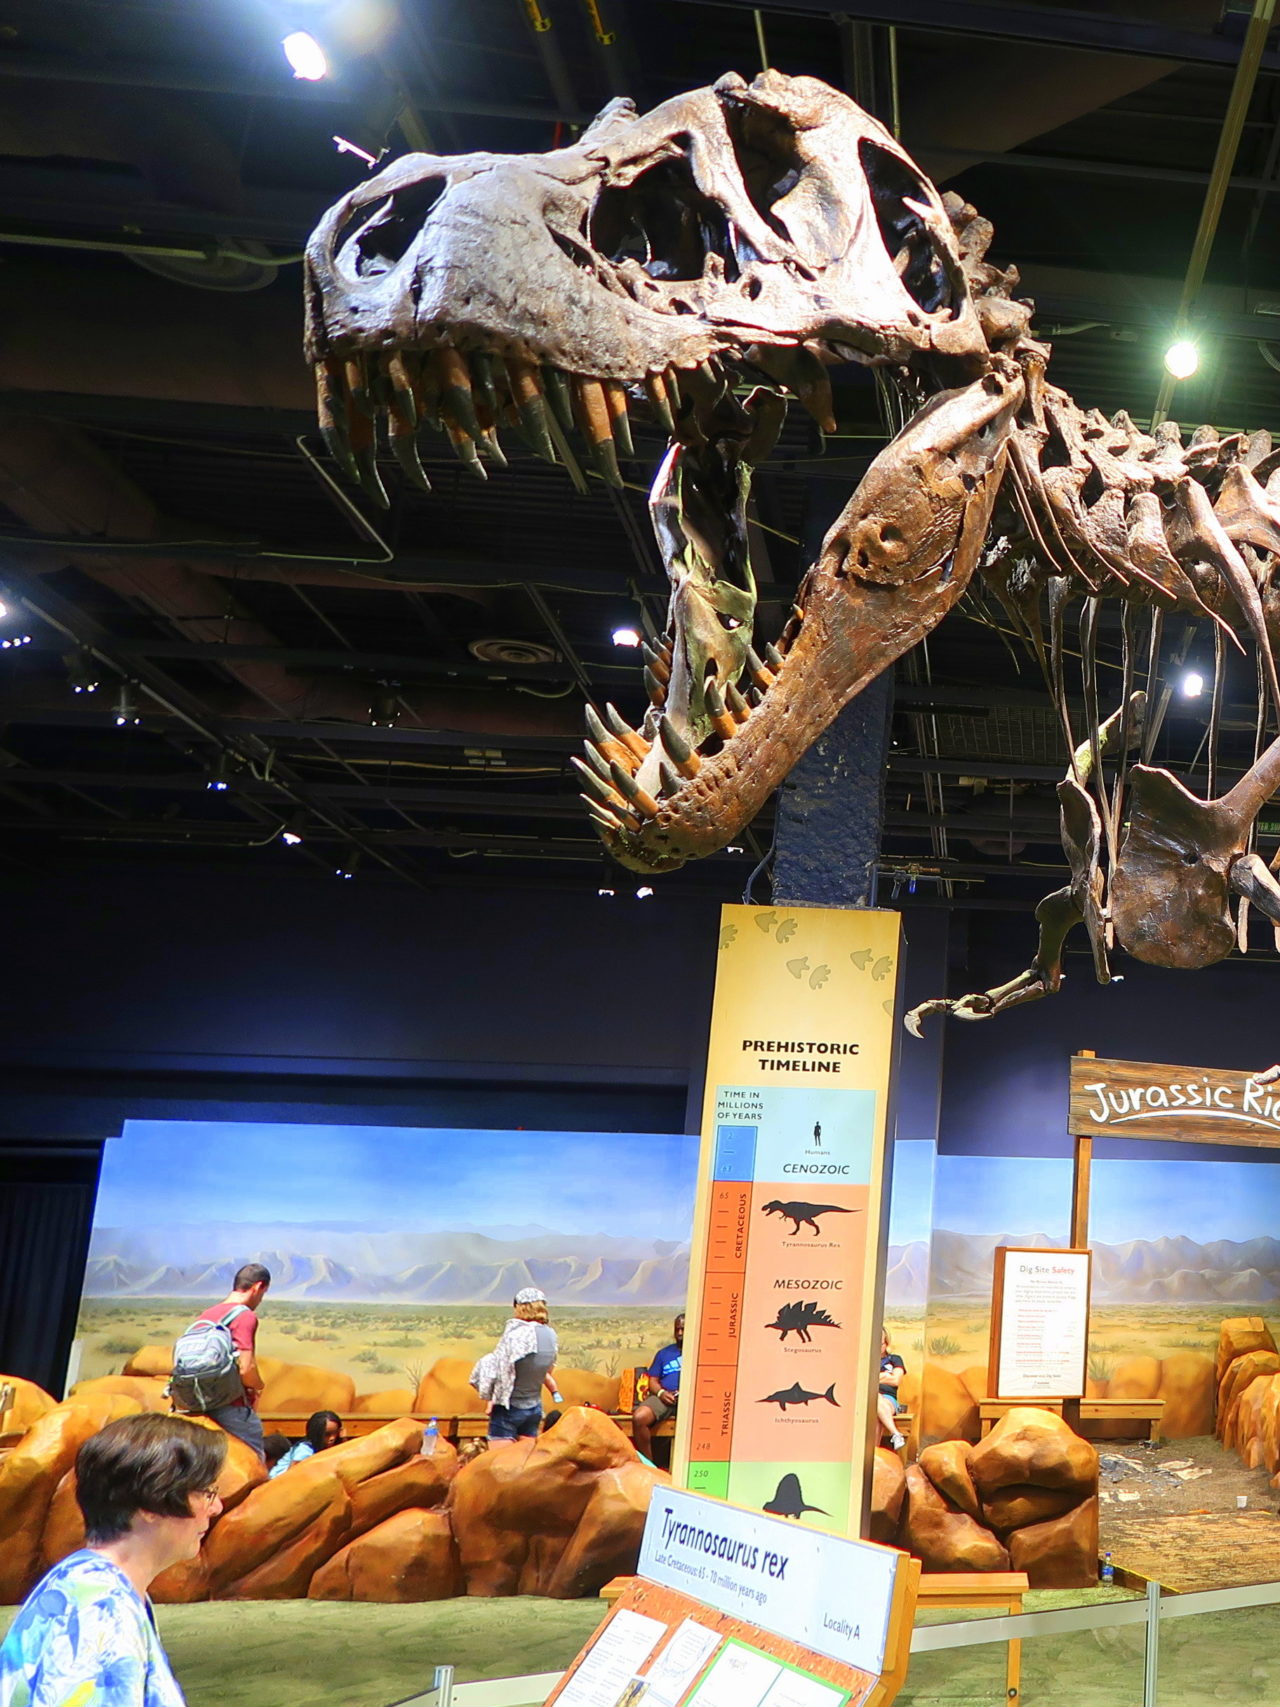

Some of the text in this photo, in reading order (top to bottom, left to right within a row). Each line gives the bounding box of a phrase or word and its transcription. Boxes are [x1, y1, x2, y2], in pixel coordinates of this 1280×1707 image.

[742, 1039, 860, 1055] PREHISTORIC
[758, 1058, 841, 1073] TIMELINE
[724, 1090, 760, 1099] TIME IN
[1083, 1077, 1233, 1123] Jurassic
[717, 1101, 764, 1110] MILLIONS
[717, 1111, 763, 1121] OF YEARS
[783, 1163, 851, 1175] CENOZOIC
[719, 1192, 729, 1200] 65
[735, 1193, 747, 1259] CRETACEOUS
[781, 1241, 828, 1249] Tyrannosaurus
[1020, 1264, 1075, 1275] Dig Site Safety
[773, 1279, 844, 1291] MESOZOIC
[728, 1292, 739, 1338] JURASSIC
[784, 1346, 822, 1354] Stegosaurus
[721, 1391, 732, 1436] TRIASSIC
[696, 1442, 711, 1451] 248
[694, 1470, 709, 1478] 250
[661, 1507, 789, 1581] Tyrannosaurus rex
[654, 1550, 667, 1565] Late
[717, 1574, 738, 1593] million
[737, 1583, 755, 1598] years
[755, 1591, 768, 1607] ago
[823, 1613, 861, 1641] Locality A
